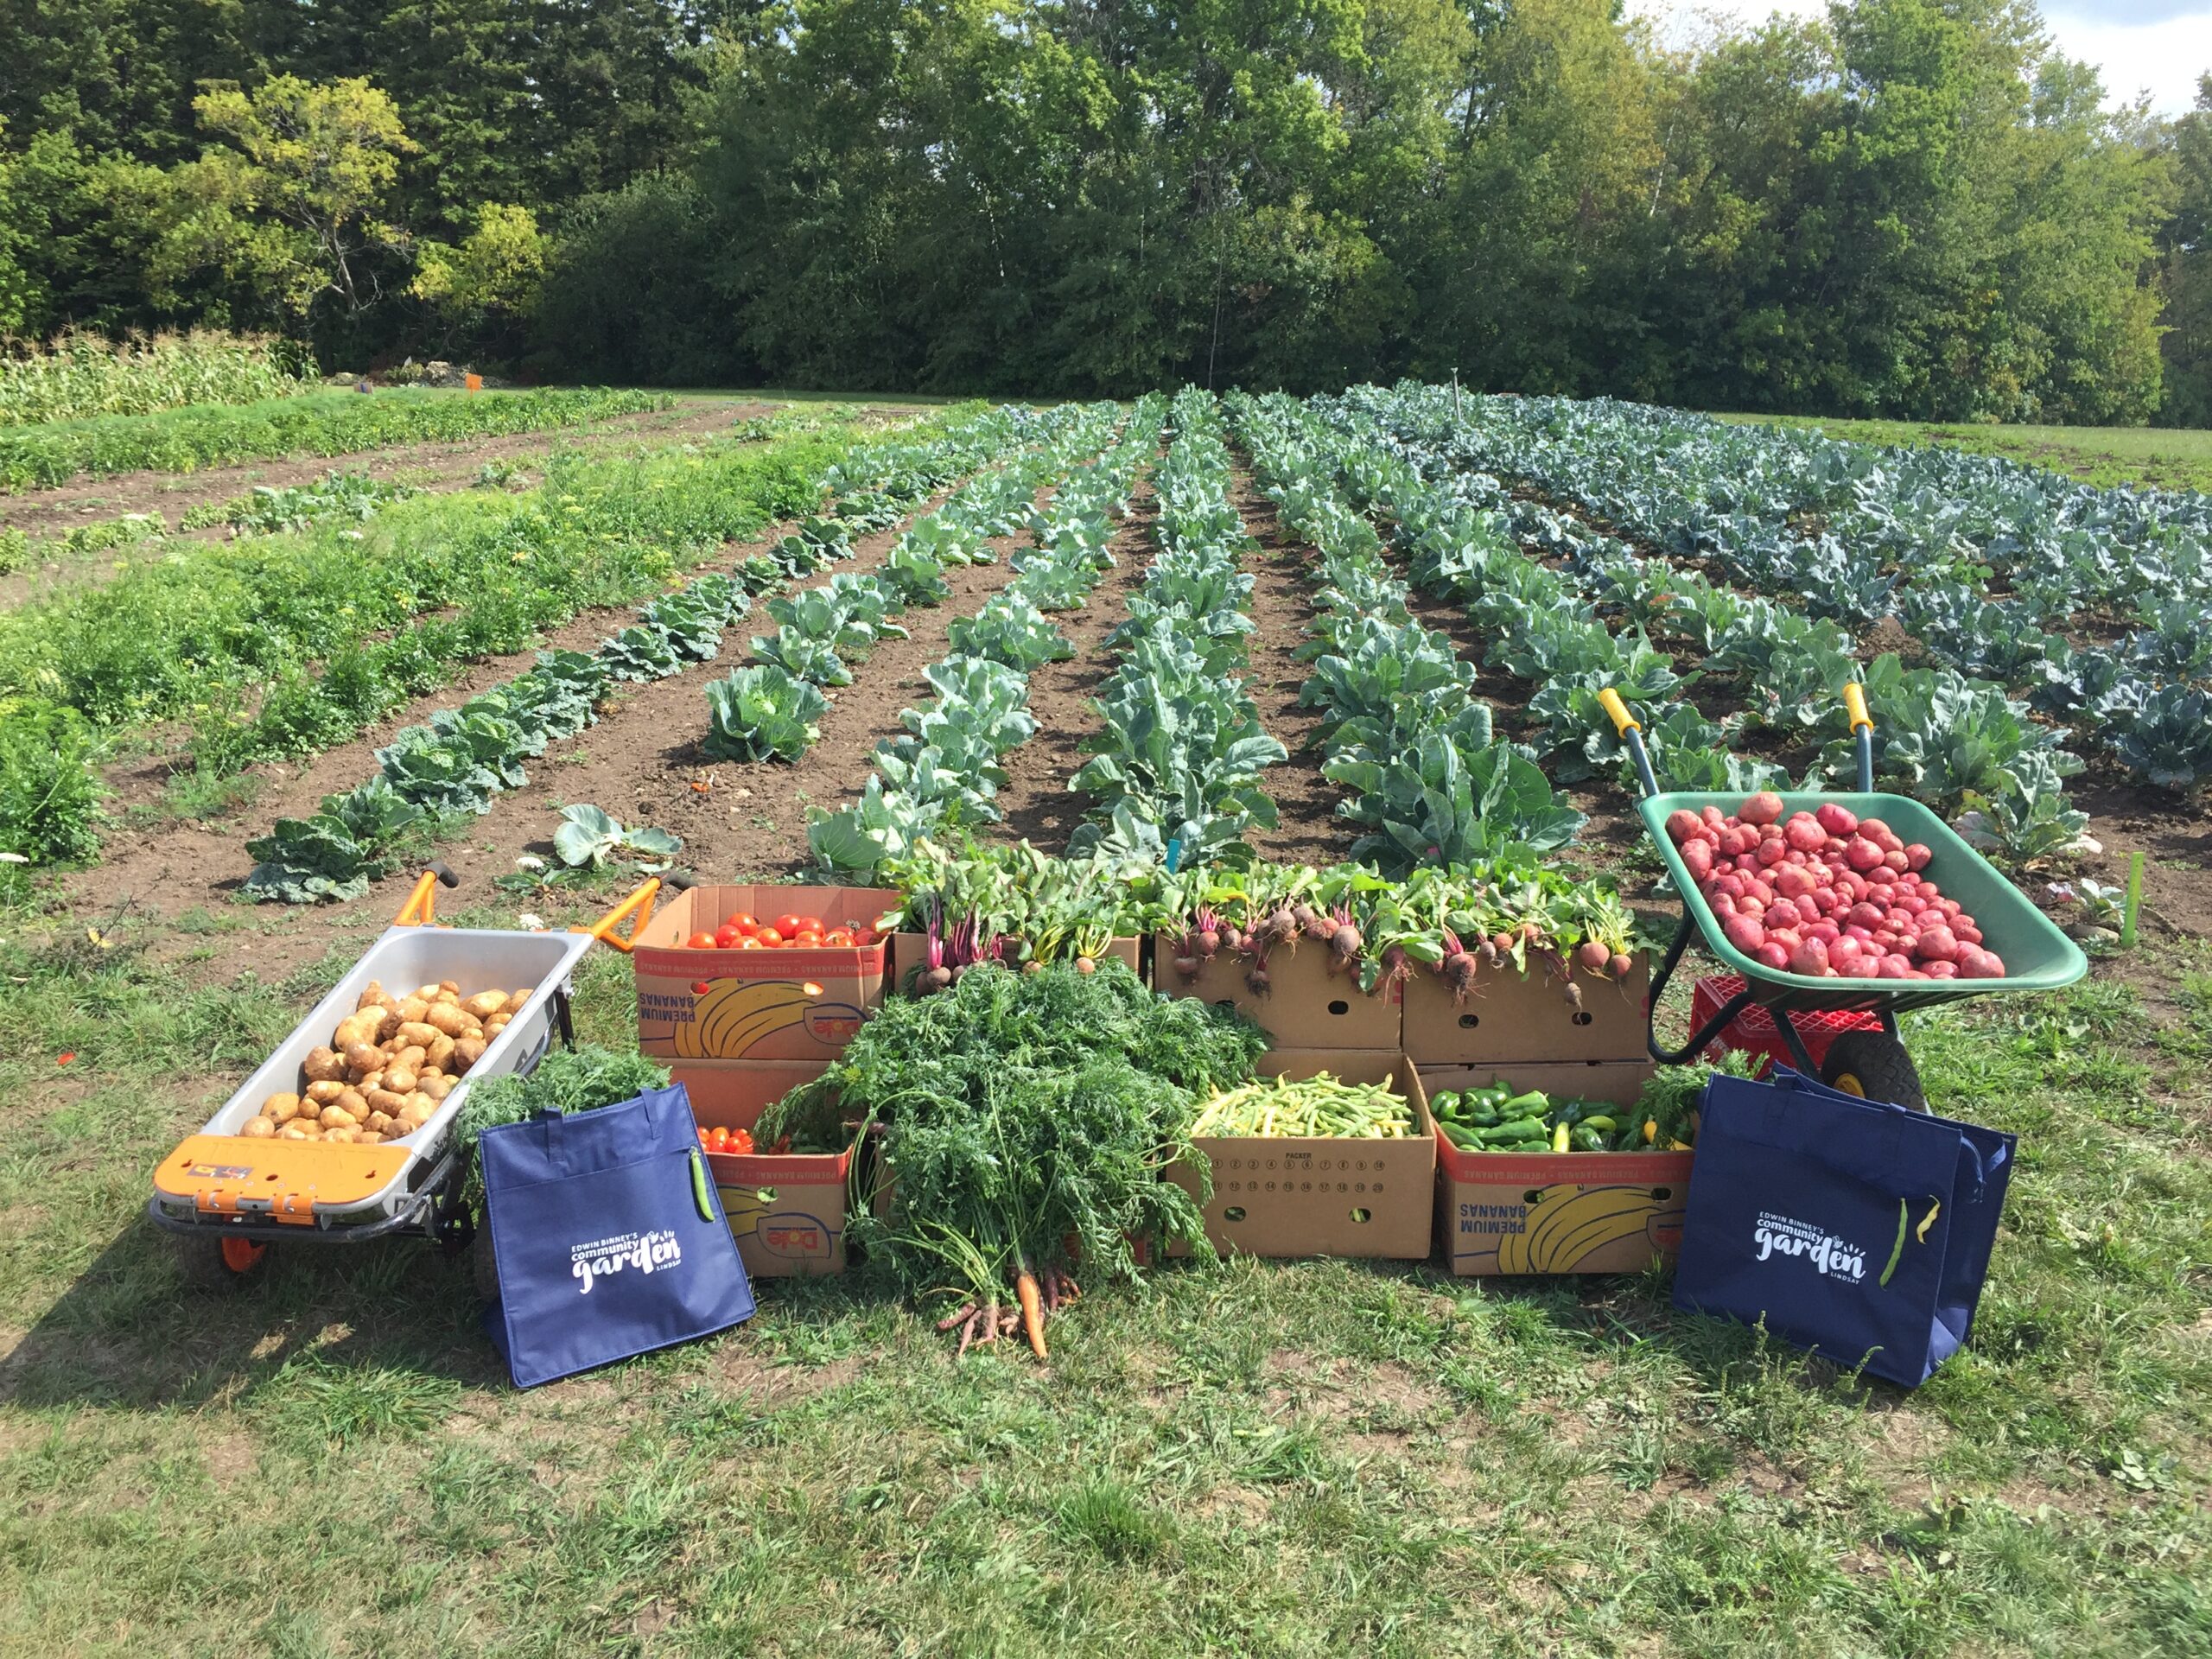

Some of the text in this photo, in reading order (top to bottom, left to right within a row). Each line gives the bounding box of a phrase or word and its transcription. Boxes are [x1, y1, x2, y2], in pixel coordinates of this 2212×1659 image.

[640, 992, 696, 1007] BANANAS
[640, 1007, 696, 1023] PREMIUM
[1460, 1203, 1527, 1218] BANANAS
[1461, 1220, 1526, 1234] PREMIUM
[1757, 1218, 1824, 1244] community
[1759, 1211, 1825, 1235] EDWIN BINNEY'S
[571, 1232, 638, 1253] EDWIN BINNEY'S
[767, 1231, 817, 1250] Dole
[571, 1240, 639, 1262] community
[1755, 1228, 1866, 1279] garden
[572, 1236, 681, 1294] garden
[657, 1259, 681, 1271] LINDSAY
[1830, 1271, 1859, 1285] LINDSAY
